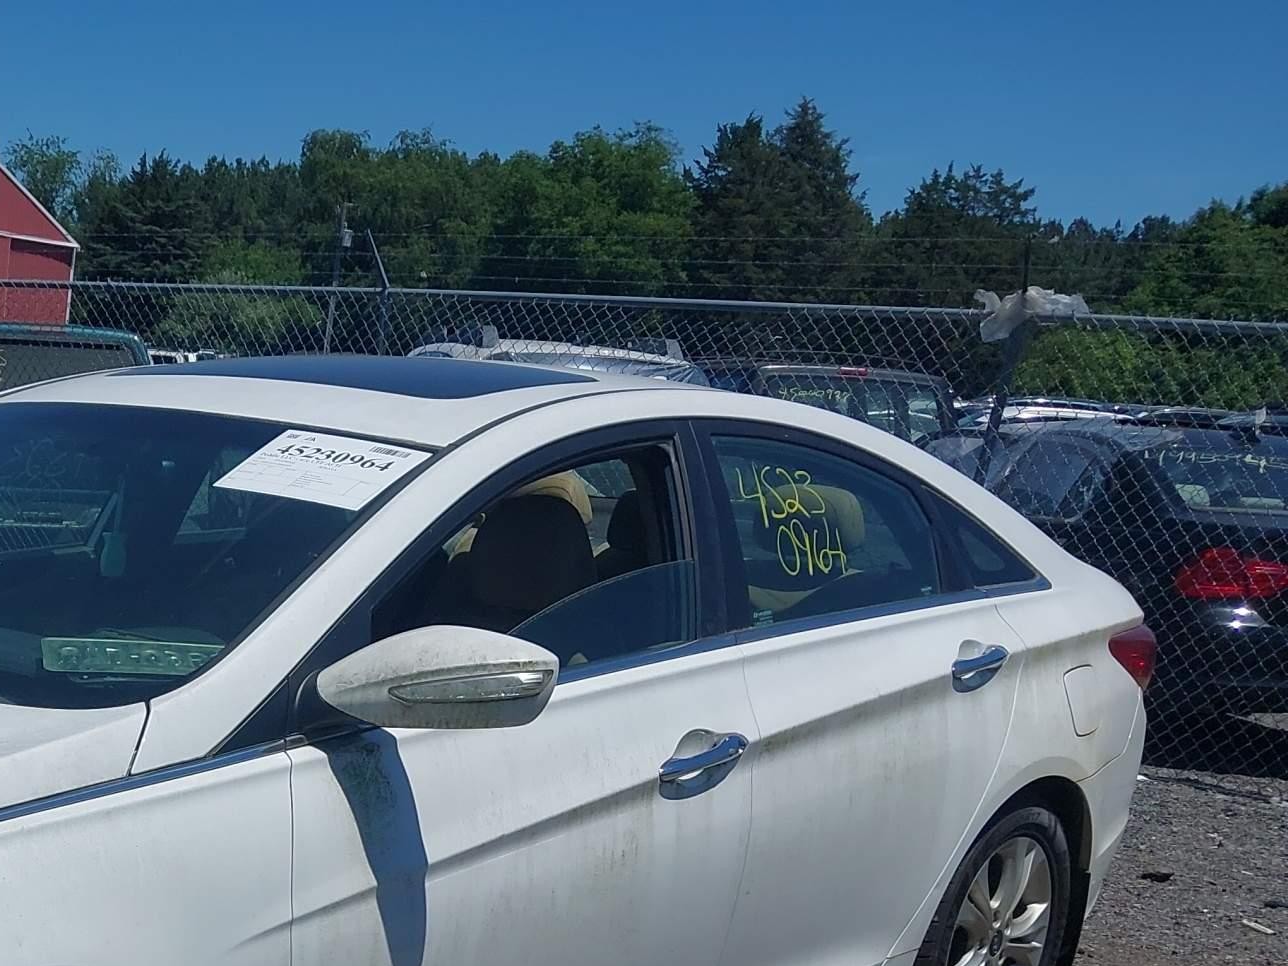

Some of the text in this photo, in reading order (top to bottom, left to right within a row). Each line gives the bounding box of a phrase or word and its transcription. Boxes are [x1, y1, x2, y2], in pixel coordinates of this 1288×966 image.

[277, 443, 395, 471] 45230964
[735, 461, 826, 528] 4523
[777, 517, 847, 576] 0964
